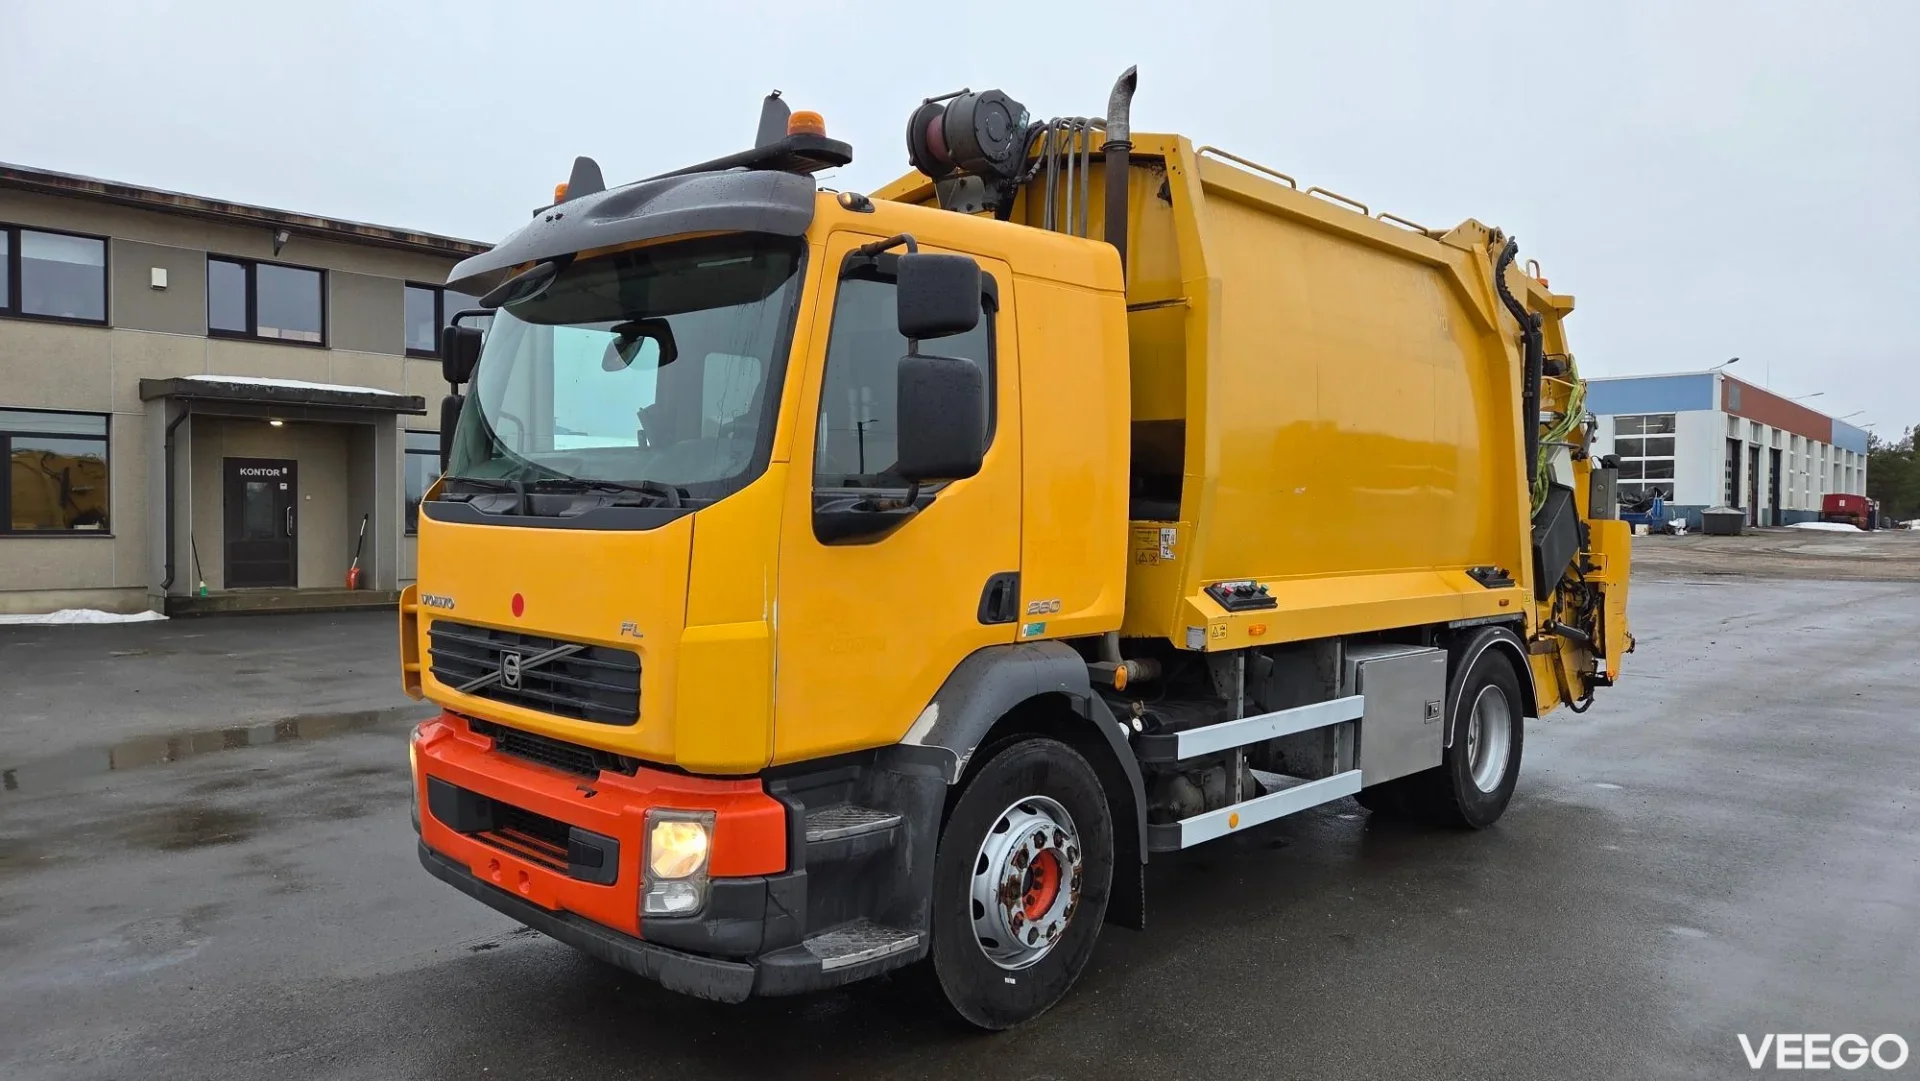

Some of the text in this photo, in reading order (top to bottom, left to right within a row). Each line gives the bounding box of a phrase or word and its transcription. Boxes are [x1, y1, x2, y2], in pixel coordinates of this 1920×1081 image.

[240, 467, 280, 476] KONTOR
[1027, 600, 1061, 615] 260
[621, 622, 644, 638] FL
